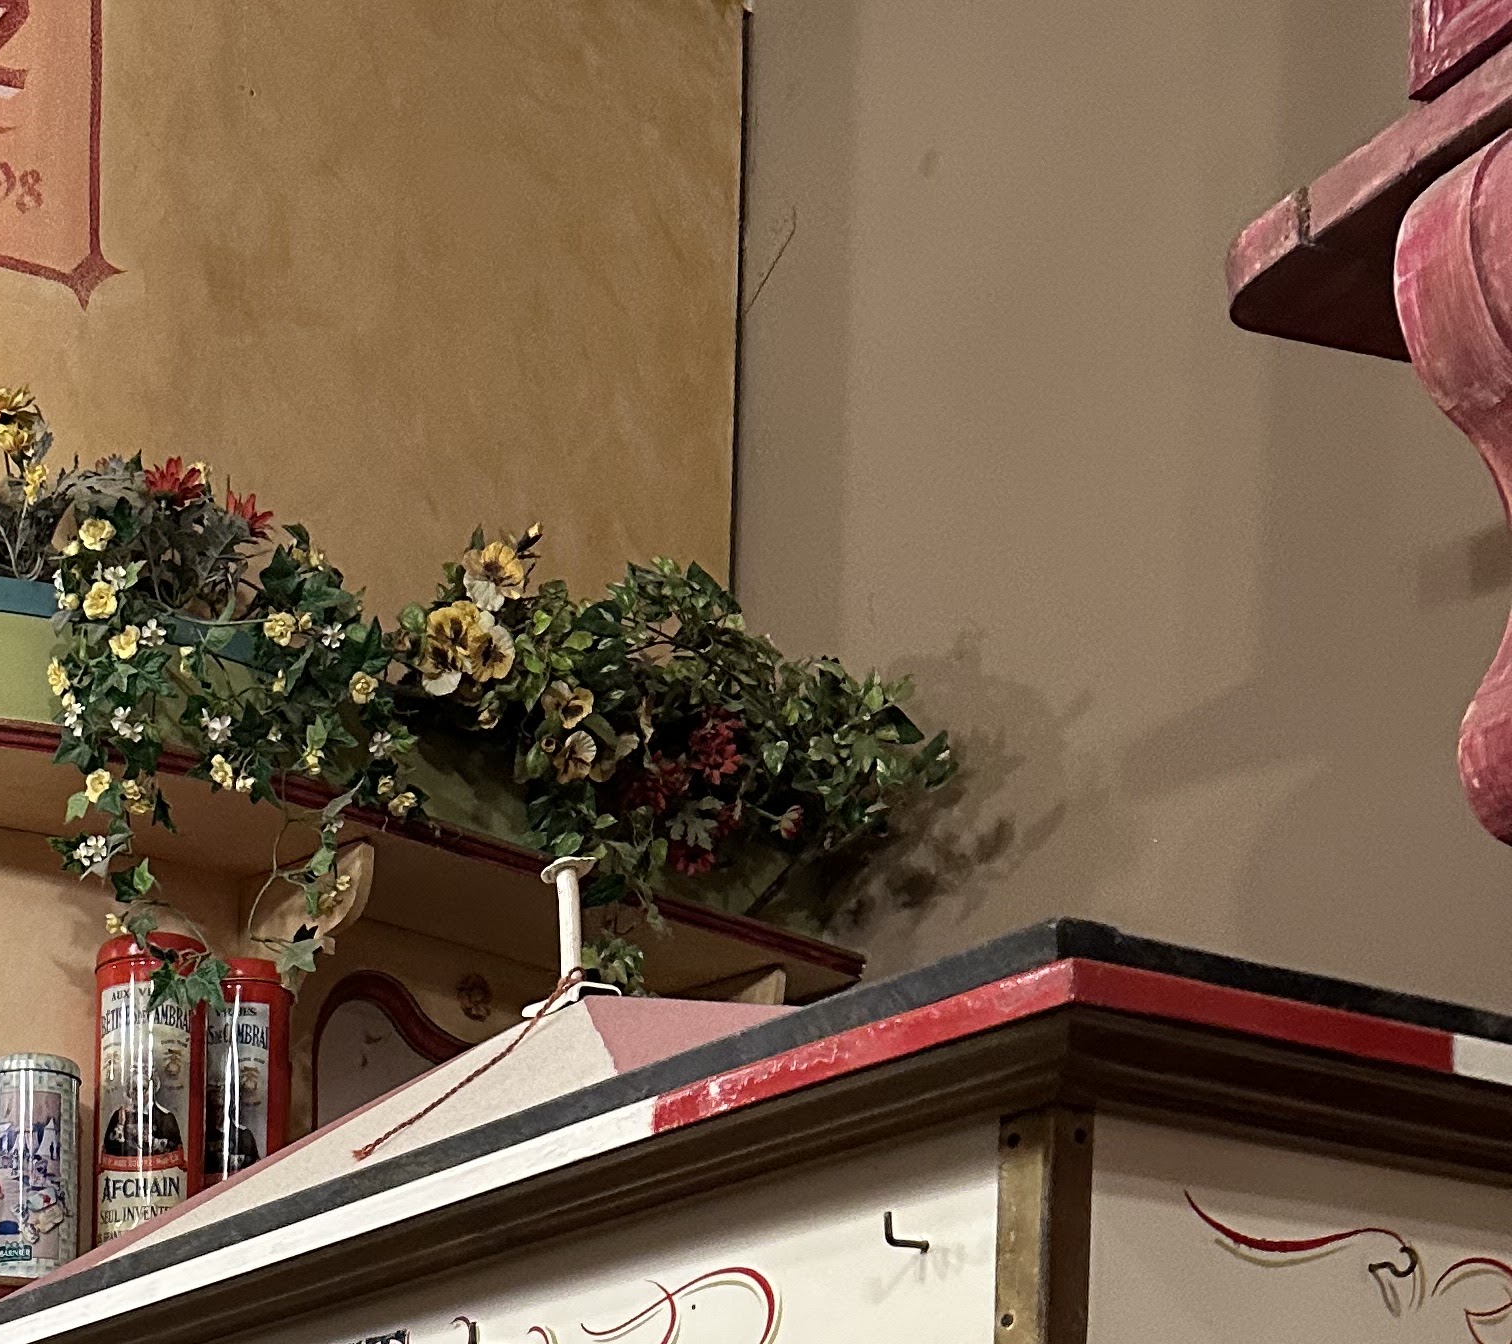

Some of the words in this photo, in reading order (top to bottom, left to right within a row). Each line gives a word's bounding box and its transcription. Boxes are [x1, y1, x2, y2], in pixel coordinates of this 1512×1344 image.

[102, 1176, 180, 1203] AFCHAIN
[100, 1208, 121, 1224] SEUL
[123, 1205, 174, 1223] INVENTE
